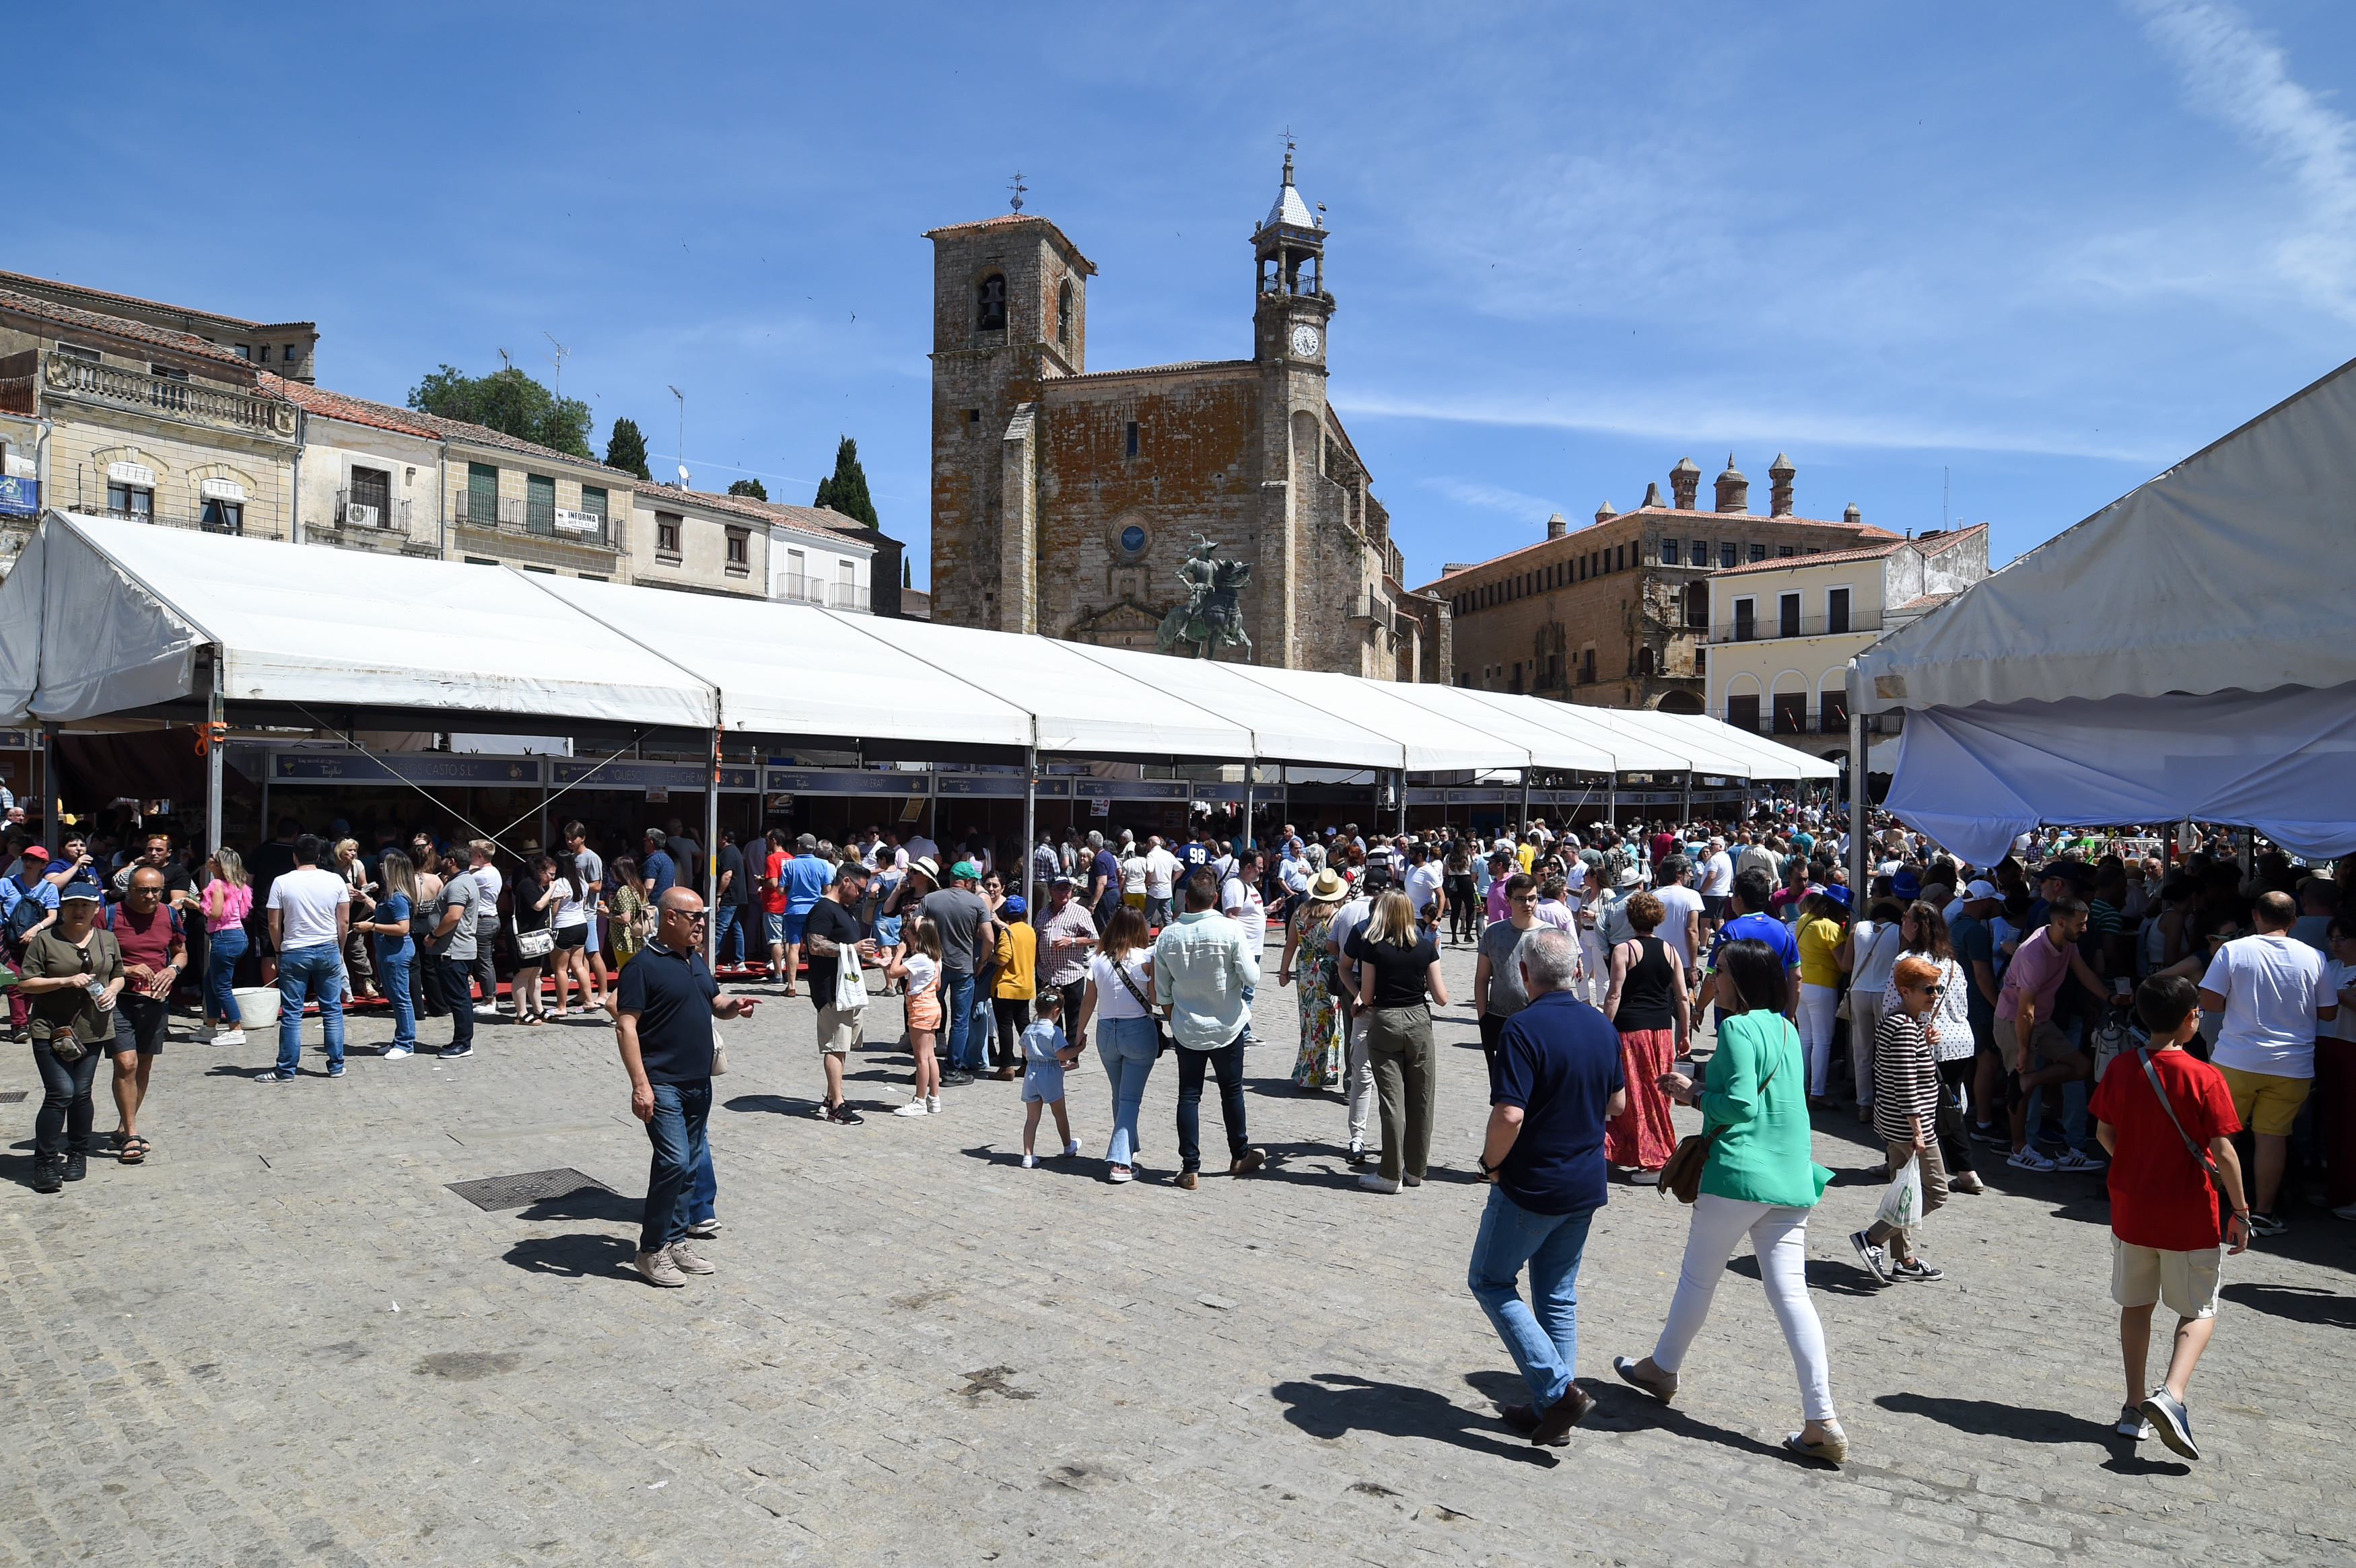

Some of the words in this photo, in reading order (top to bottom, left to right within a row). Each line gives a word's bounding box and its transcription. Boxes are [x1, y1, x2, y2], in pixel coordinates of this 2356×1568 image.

[568, 511, 596, 523] INFORMA
[425, 764, 457, 776] CASTO
[644, 771, 653, 781] DE
[1189, 847, 1206, 865] 98
